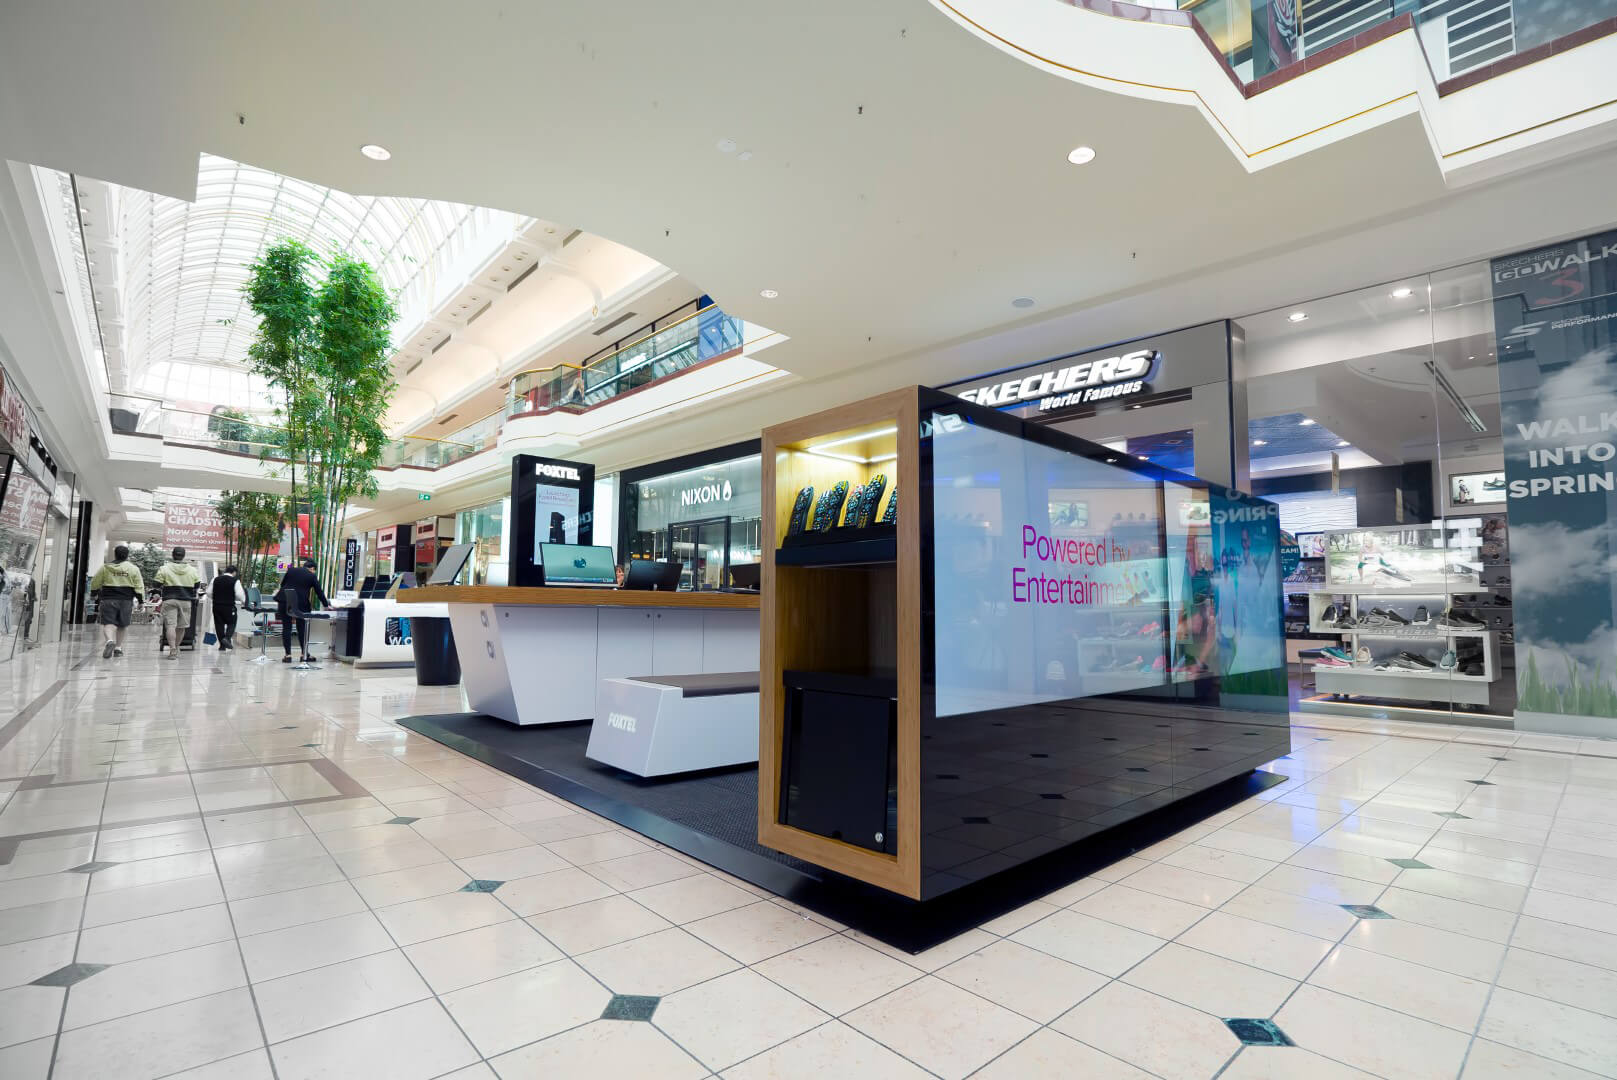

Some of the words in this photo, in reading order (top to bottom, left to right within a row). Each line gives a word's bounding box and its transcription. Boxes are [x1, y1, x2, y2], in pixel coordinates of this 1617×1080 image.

[1552, 312, 1617, 330] PERFORMAN
[957, 349, 1154, 406] SKECHERS
[1038, 390, 1082, 411] World
[1083, 380, 1144, 403] Famous
[1528, 442, 1616, 469] INTO
[535, 463, 581, 481] FOXTEL
[681, 484, 720, 507] NIXON
[1508, 471, 1617, 499] SPRIN
[168, 506, 200, 516] NEW
[167, 527, 190, 536] Now
[192, 529, 219, 538] Open
[1022, 524, 1107, 567] Powered
[607, 711, 636, 733] FOXTEL
